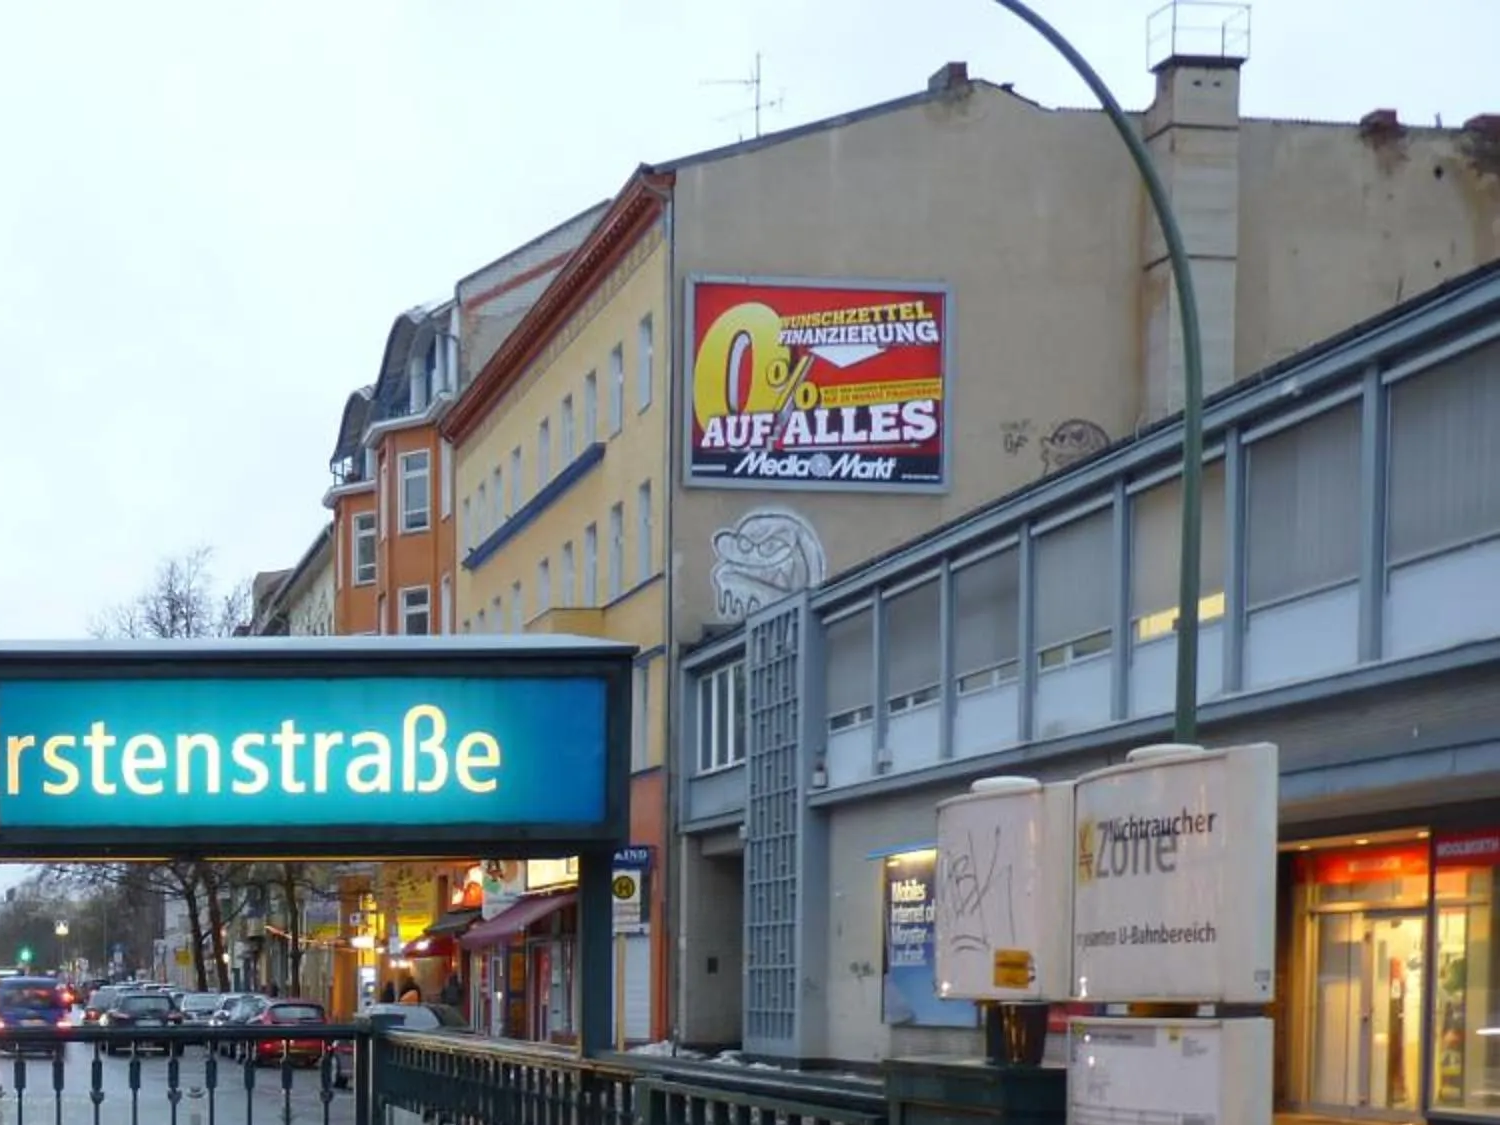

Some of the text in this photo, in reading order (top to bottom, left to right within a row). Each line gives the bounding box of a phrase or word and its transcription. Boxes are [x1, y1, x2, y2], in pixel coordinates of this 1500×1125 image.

[778, 320, 940, 346] FINANZIERUNG
[701, 399, 938, 448] AUF ALLES
[733, 451, 897, 479] Media Markt
[1119, 920, 1217, 945] U-Bahnbereich
